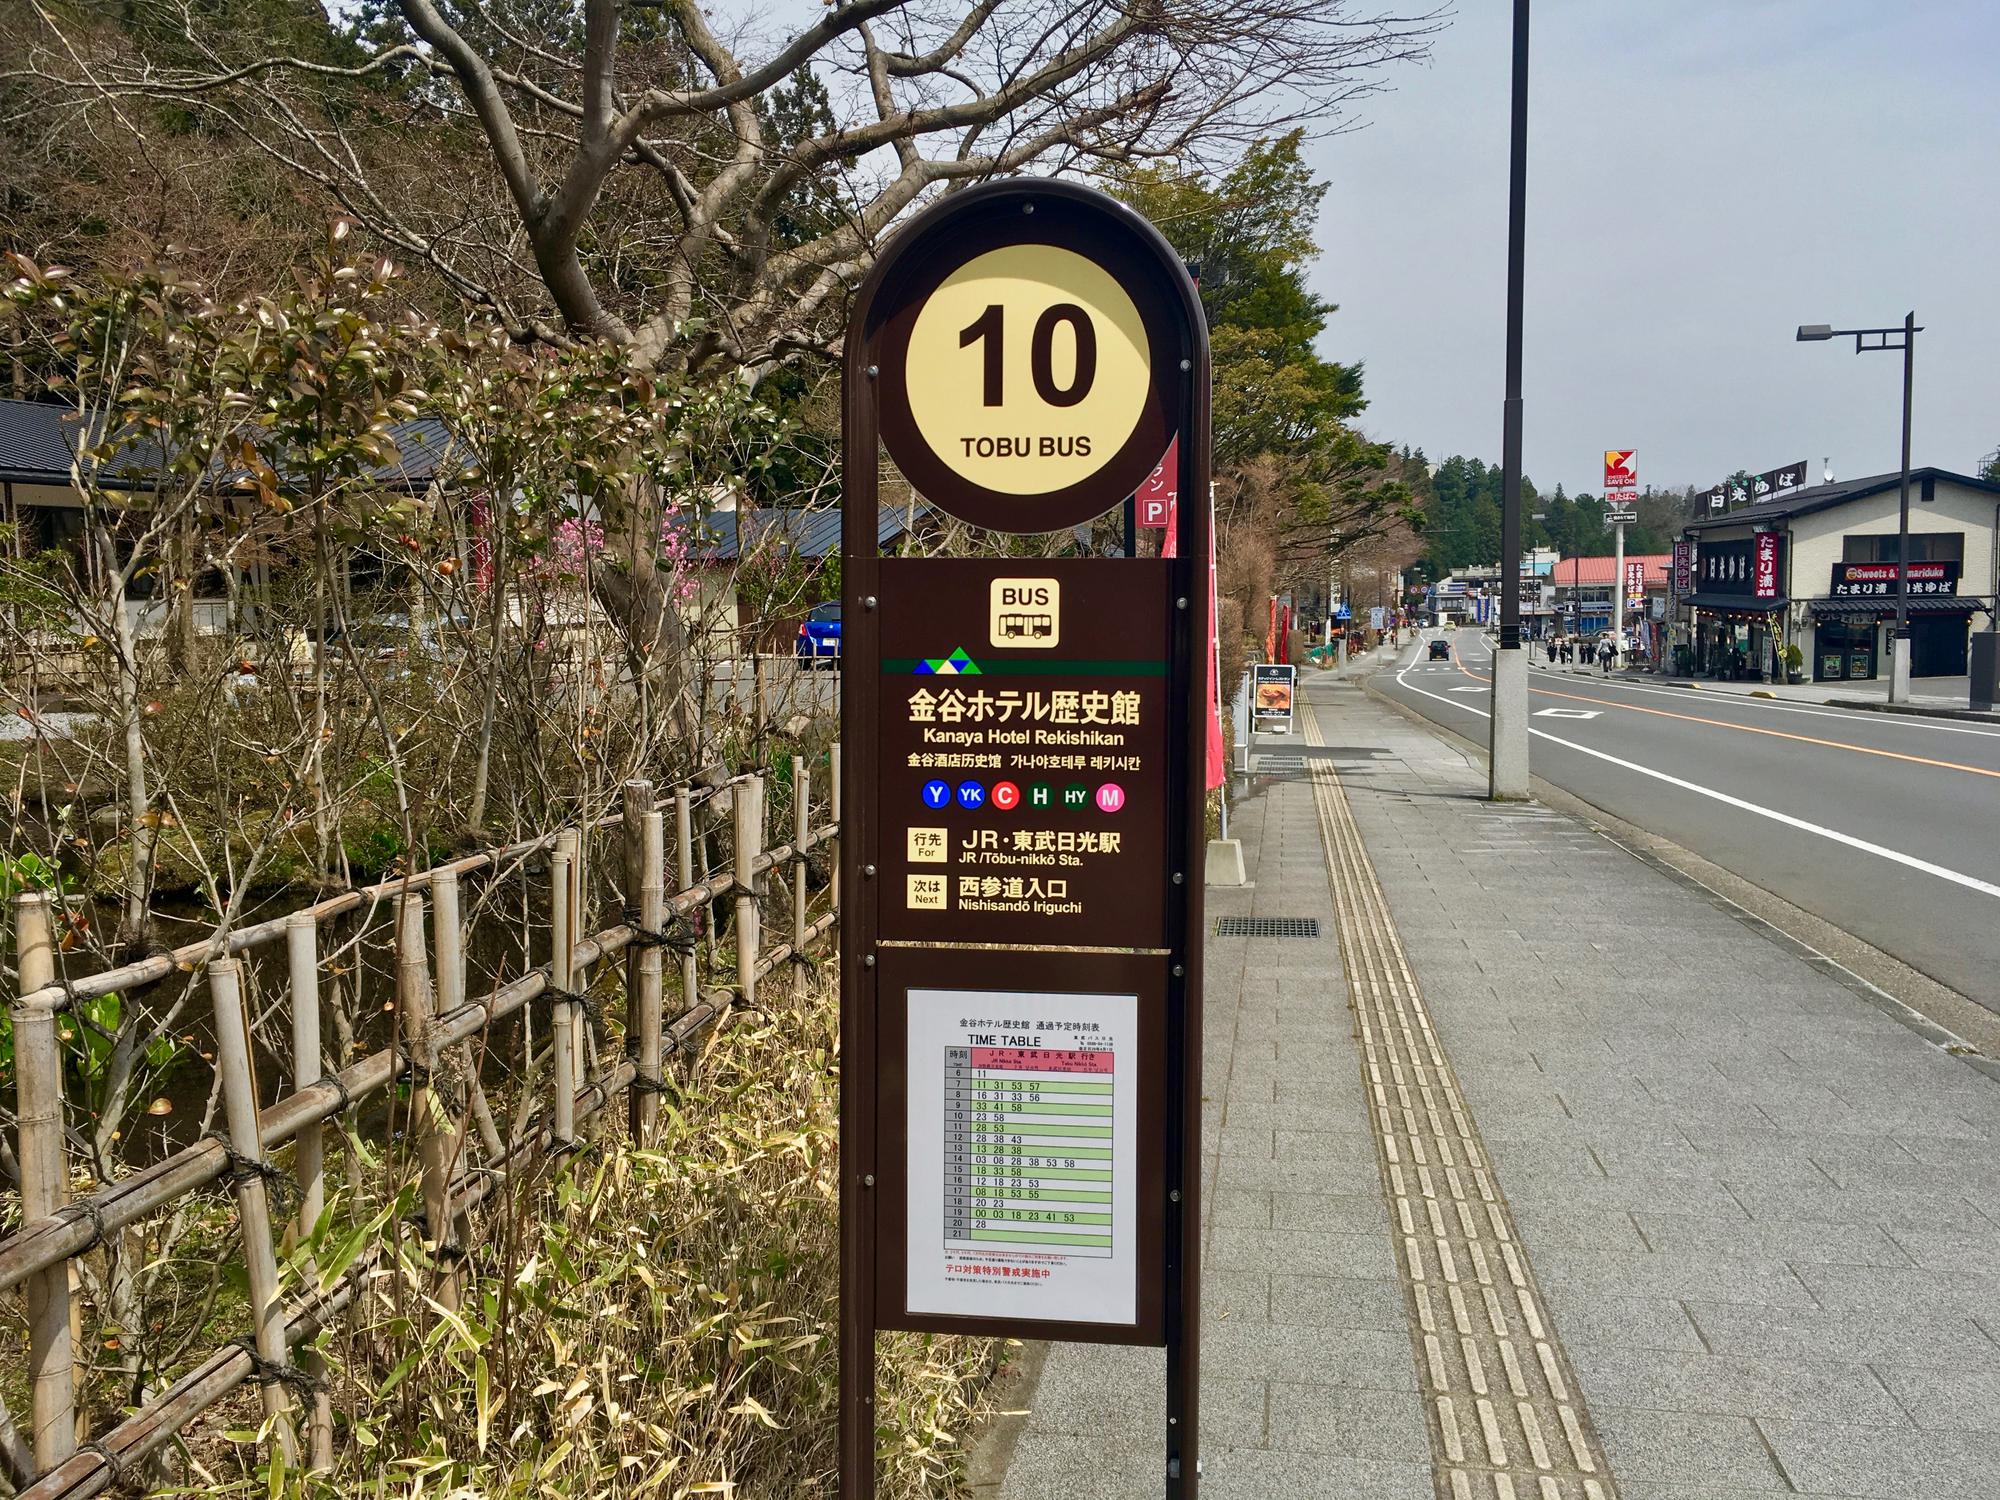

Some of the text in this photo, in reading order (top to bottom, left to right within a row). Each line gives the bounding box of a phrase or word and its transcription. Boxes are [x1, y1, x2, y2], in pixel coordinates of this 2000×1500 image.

[959, 303, 1097, 408] 10
[960, 436, 1091, 458] TOBU BUS
[1616, 492, 1637, 501] たばこ
[1710, 472, 1796, 508] 日光ゆば
[1148, 502, 1162, 521] P
[1677, 546, 1689, 588] 日光ゆば
[1759, 535, 1774, 588] たまり漬
[1856, 568, 1887, 578] Sweets
[1888, 568, 1896, 578] &
[1836, 583, 1888, 594] たまり漬
[1002, 587, 1049, 606] BUS
[907, 688, 1140, 725] 金谷ホテル歴史館
[924, 728, 1124, 747] Kanaya Hotel Rekishikan
[907, 753, 1002, 769] 金谷酒店历史馆
[1010, 754, 1140, 771] 가나야호테루 레키시칸
[929, 786, 1119, 807] Y YK C H HY M
[914, 833, 942, 847] 行先
[962, 830, 1121, 853] JR・東武日光駅
[918, 847, 935, 857] For
[959, 853, 976, 864] JR
[1058, 853, 1084, 866] Sta.
[913, 880, 941, 894] 次は
[959, 876, 1067, 899] 西参道入口
[915, 894, 938, 904] Next
[958, 899, 1082, 915] Nishisandō Iriguchi
[959, 1018, 1100, 1032] 金谷ホテル歴史館 通過予定時刻表
[968, 1034, 1041, 1047] TIME TABLE
[949, 1049, 968, 1059] 時刻
[1029, 1083, 1040, 1091] 57
[994, 1092, 1003, 1100] 31
[994, 1124, 1004, 1132] 53
[994, 1135, 1004, 1143] 38
[977, 1145, 986, 1153] 13
[1011, 1157, 1022, 1165] 28
[1046, 1159, 1057, 1167] 53
[993, 1167, 1004, 1175] 33
[1011, 1168, 1022, 1176] 58
[994, 1178, 1004, 1186] 18
[1011, 1179, 1021, 1187] 23
[976, 1188, 986, 1196] 08
[1028, 1212, 1039, 1220] 23
[1046, 1213, 1056, 1221] 41
[1064, 1214, 1075, 1222] 53
[946, 1264, 1050, 1279] テロ対策特別警戒実施中
